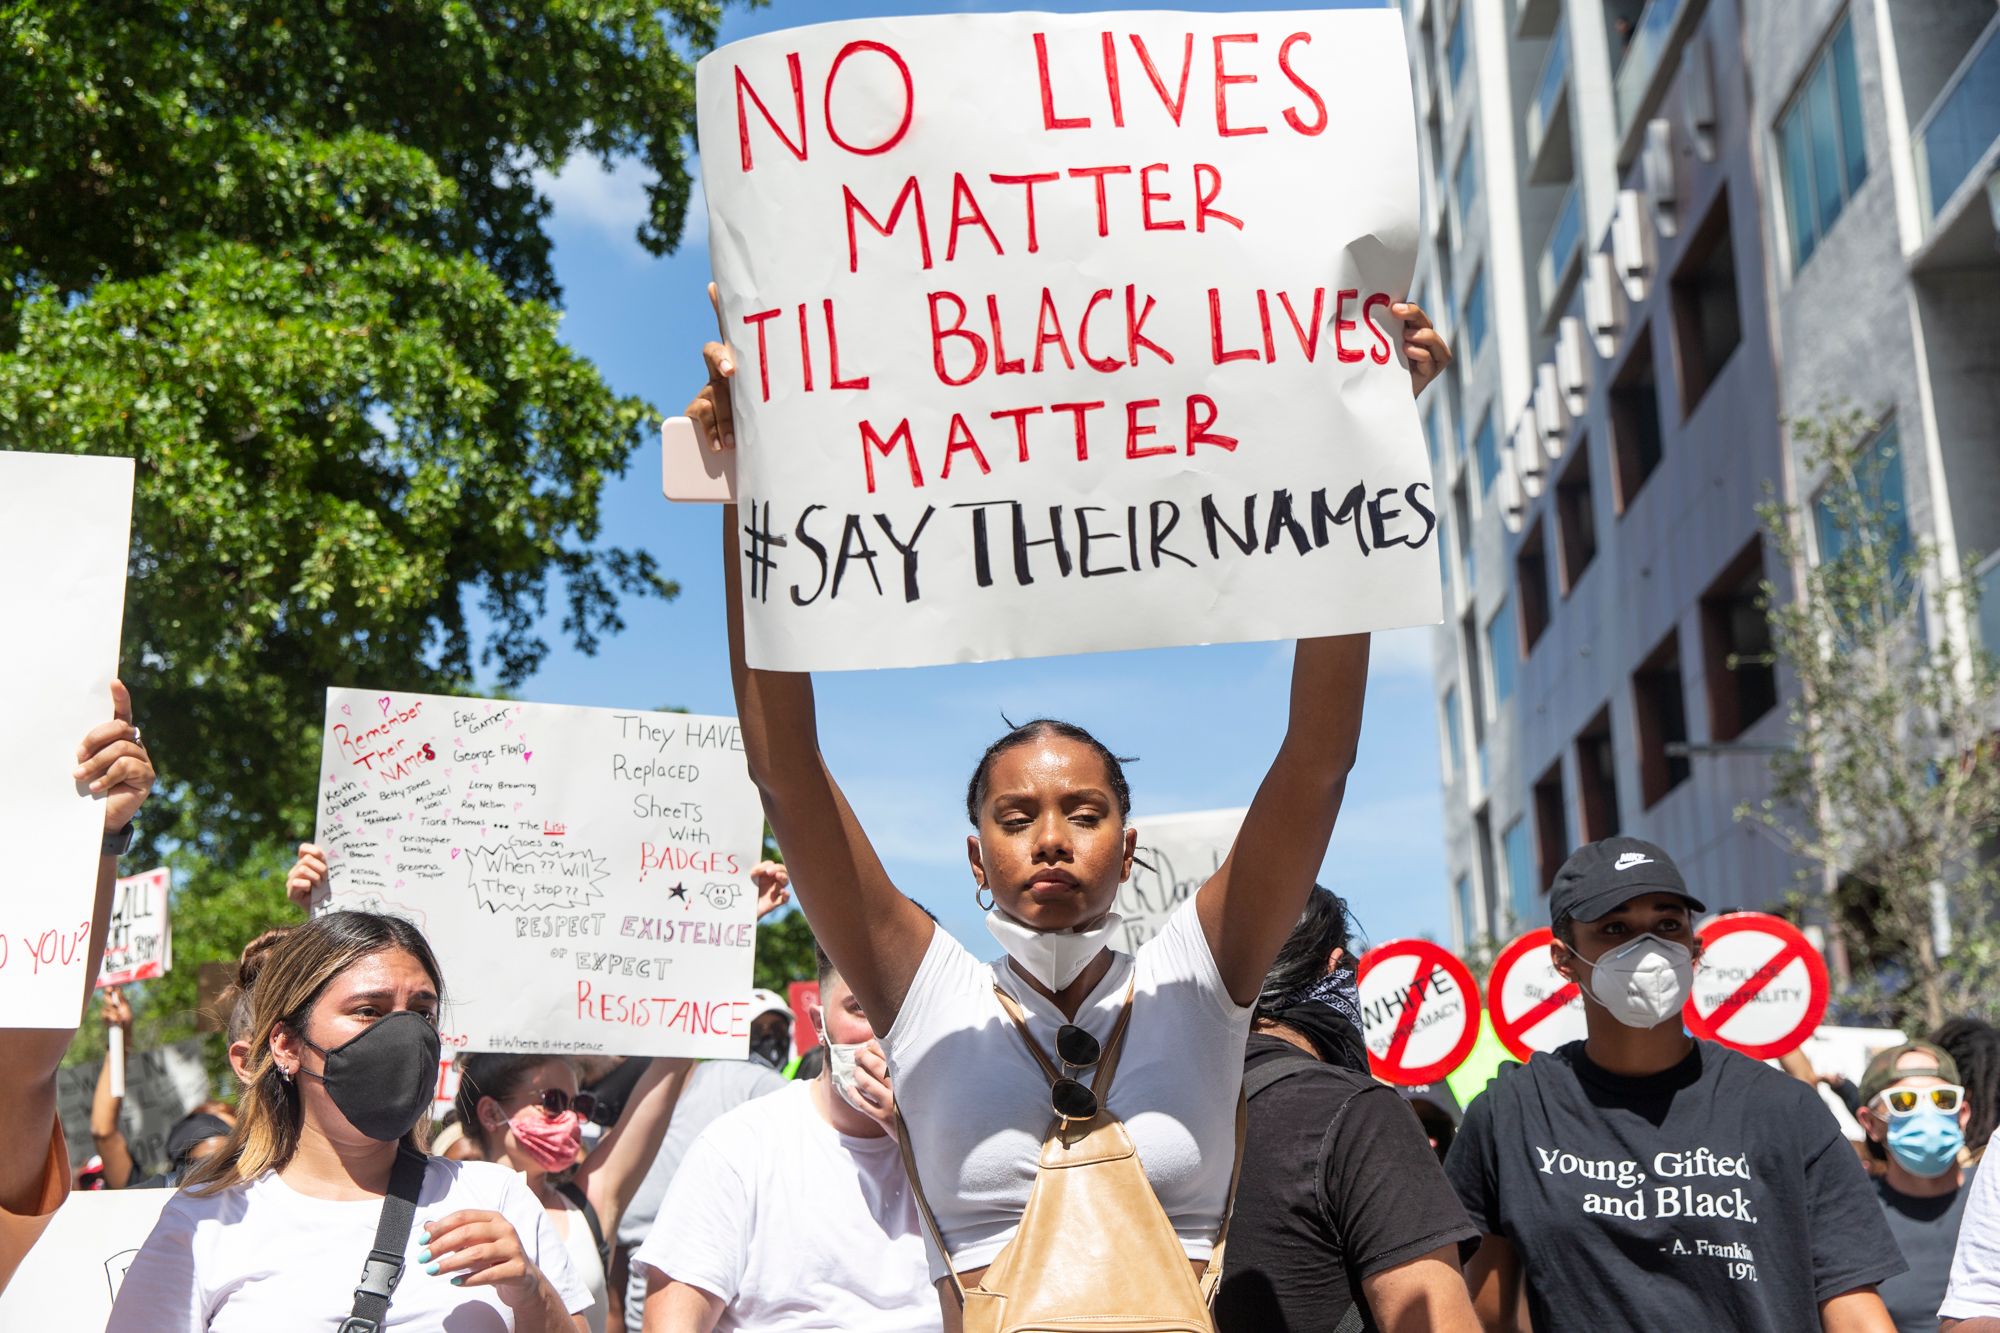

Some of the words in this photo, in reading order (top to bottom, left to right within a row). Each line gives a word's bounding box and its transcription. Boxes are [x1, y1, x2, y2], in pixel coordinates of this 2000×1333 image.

[735, 40, 915, 172] NO
[1033, 31, 1328, 137] LIVES
[842, 163, 1244, 273] MATTER
[743, 298, 870, 403] TIL
[927, 284, 1175, 387] BLACK
[1207, 287, 1393, 366] LIVES
[858, 394, 1239, 495] MATTER
[333, 701, 423, 760] Remember
[613, 714, 676, 753] They
[685, 722, 747, 751] HAVE
[352, 738, 405, 770] Their
[453, 748, 496, 766] George
[518, 820, 540, 830] The
[484, 852, 535, 874] When
[640, 842, 739, 875] BADGES
[482, 878, 526, 902] They
[24, 921, 90, 975] YOU?
[515, 912, 606, 938] RESPECT
[620, 915, 753, 948] EXISTENCE
[576, 951, 673, 981] EXPECT
[577, 979, 751, 1038] RESISTANCE
[1361, 967, 1453, 1031] WHITE
[1536, 1146, 1646, 1189] Young,
[1653, 1147, 1751, 1180] Gifted
[1583, 1189, 1647, 1221] and
[1654, 1185, 1758, 1224] Black.
[1672, 1239, 1692, 1255] A.
